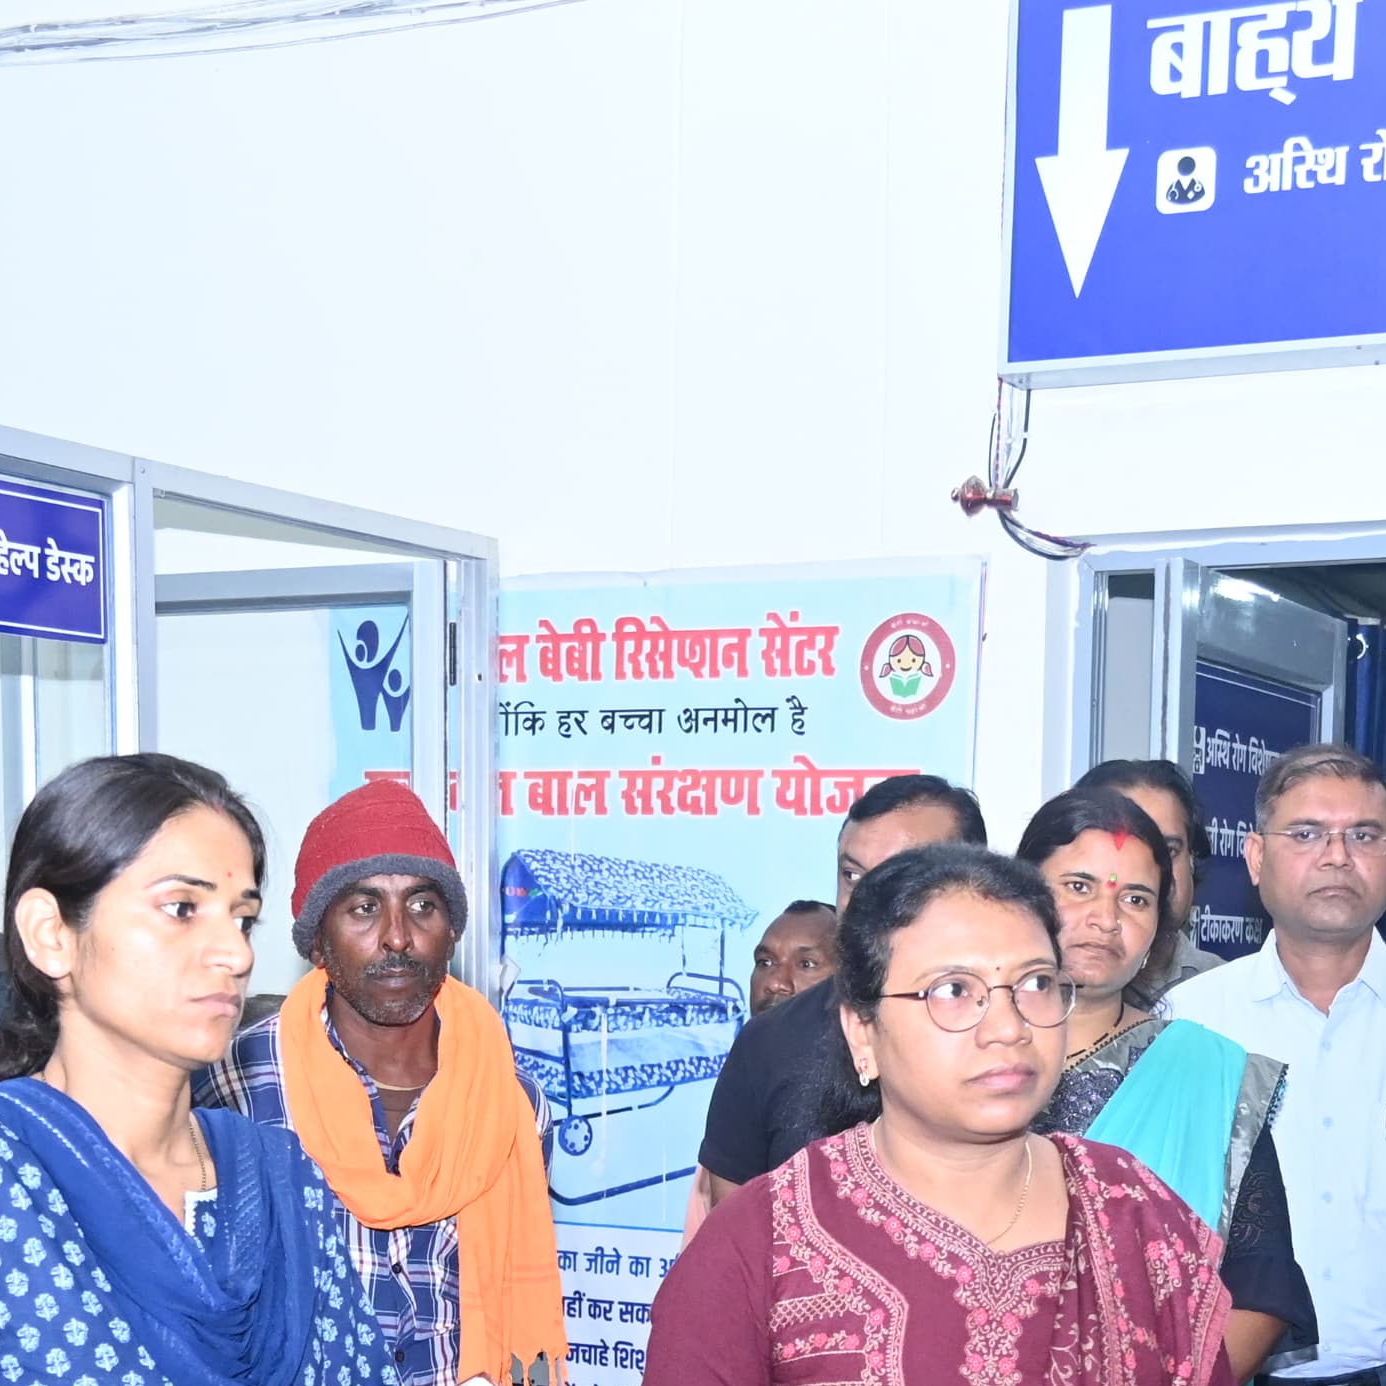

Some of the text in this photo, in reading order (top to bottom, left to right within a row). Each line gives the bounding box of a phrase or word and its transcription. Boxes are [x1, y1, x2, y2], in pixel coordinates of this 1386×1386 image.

[1243, 135, 1349, 195] अस्थि
[44, 537, 95, 587] डेस्क
[535, 611, 839, 683] बेबी रिसेप्शन सेंटर
[556, 695, 808, 738] हर बच्चा अनमोल है
[1231, 733, 1247, 773] रोग
[524, 770, 611, 816] बाल
[619, 755, 764, 816] संरक्षण
[771, 755, 921, 816] योज
[1200, 904, 1244, 944] टीकाकरण
[557, 1250, 578, 1272] का
[583, 1246, 622, 1276] जीने
[628, 1255, 652, 1278] का
[562, 1290, 652, 1324] हीं कर सक
